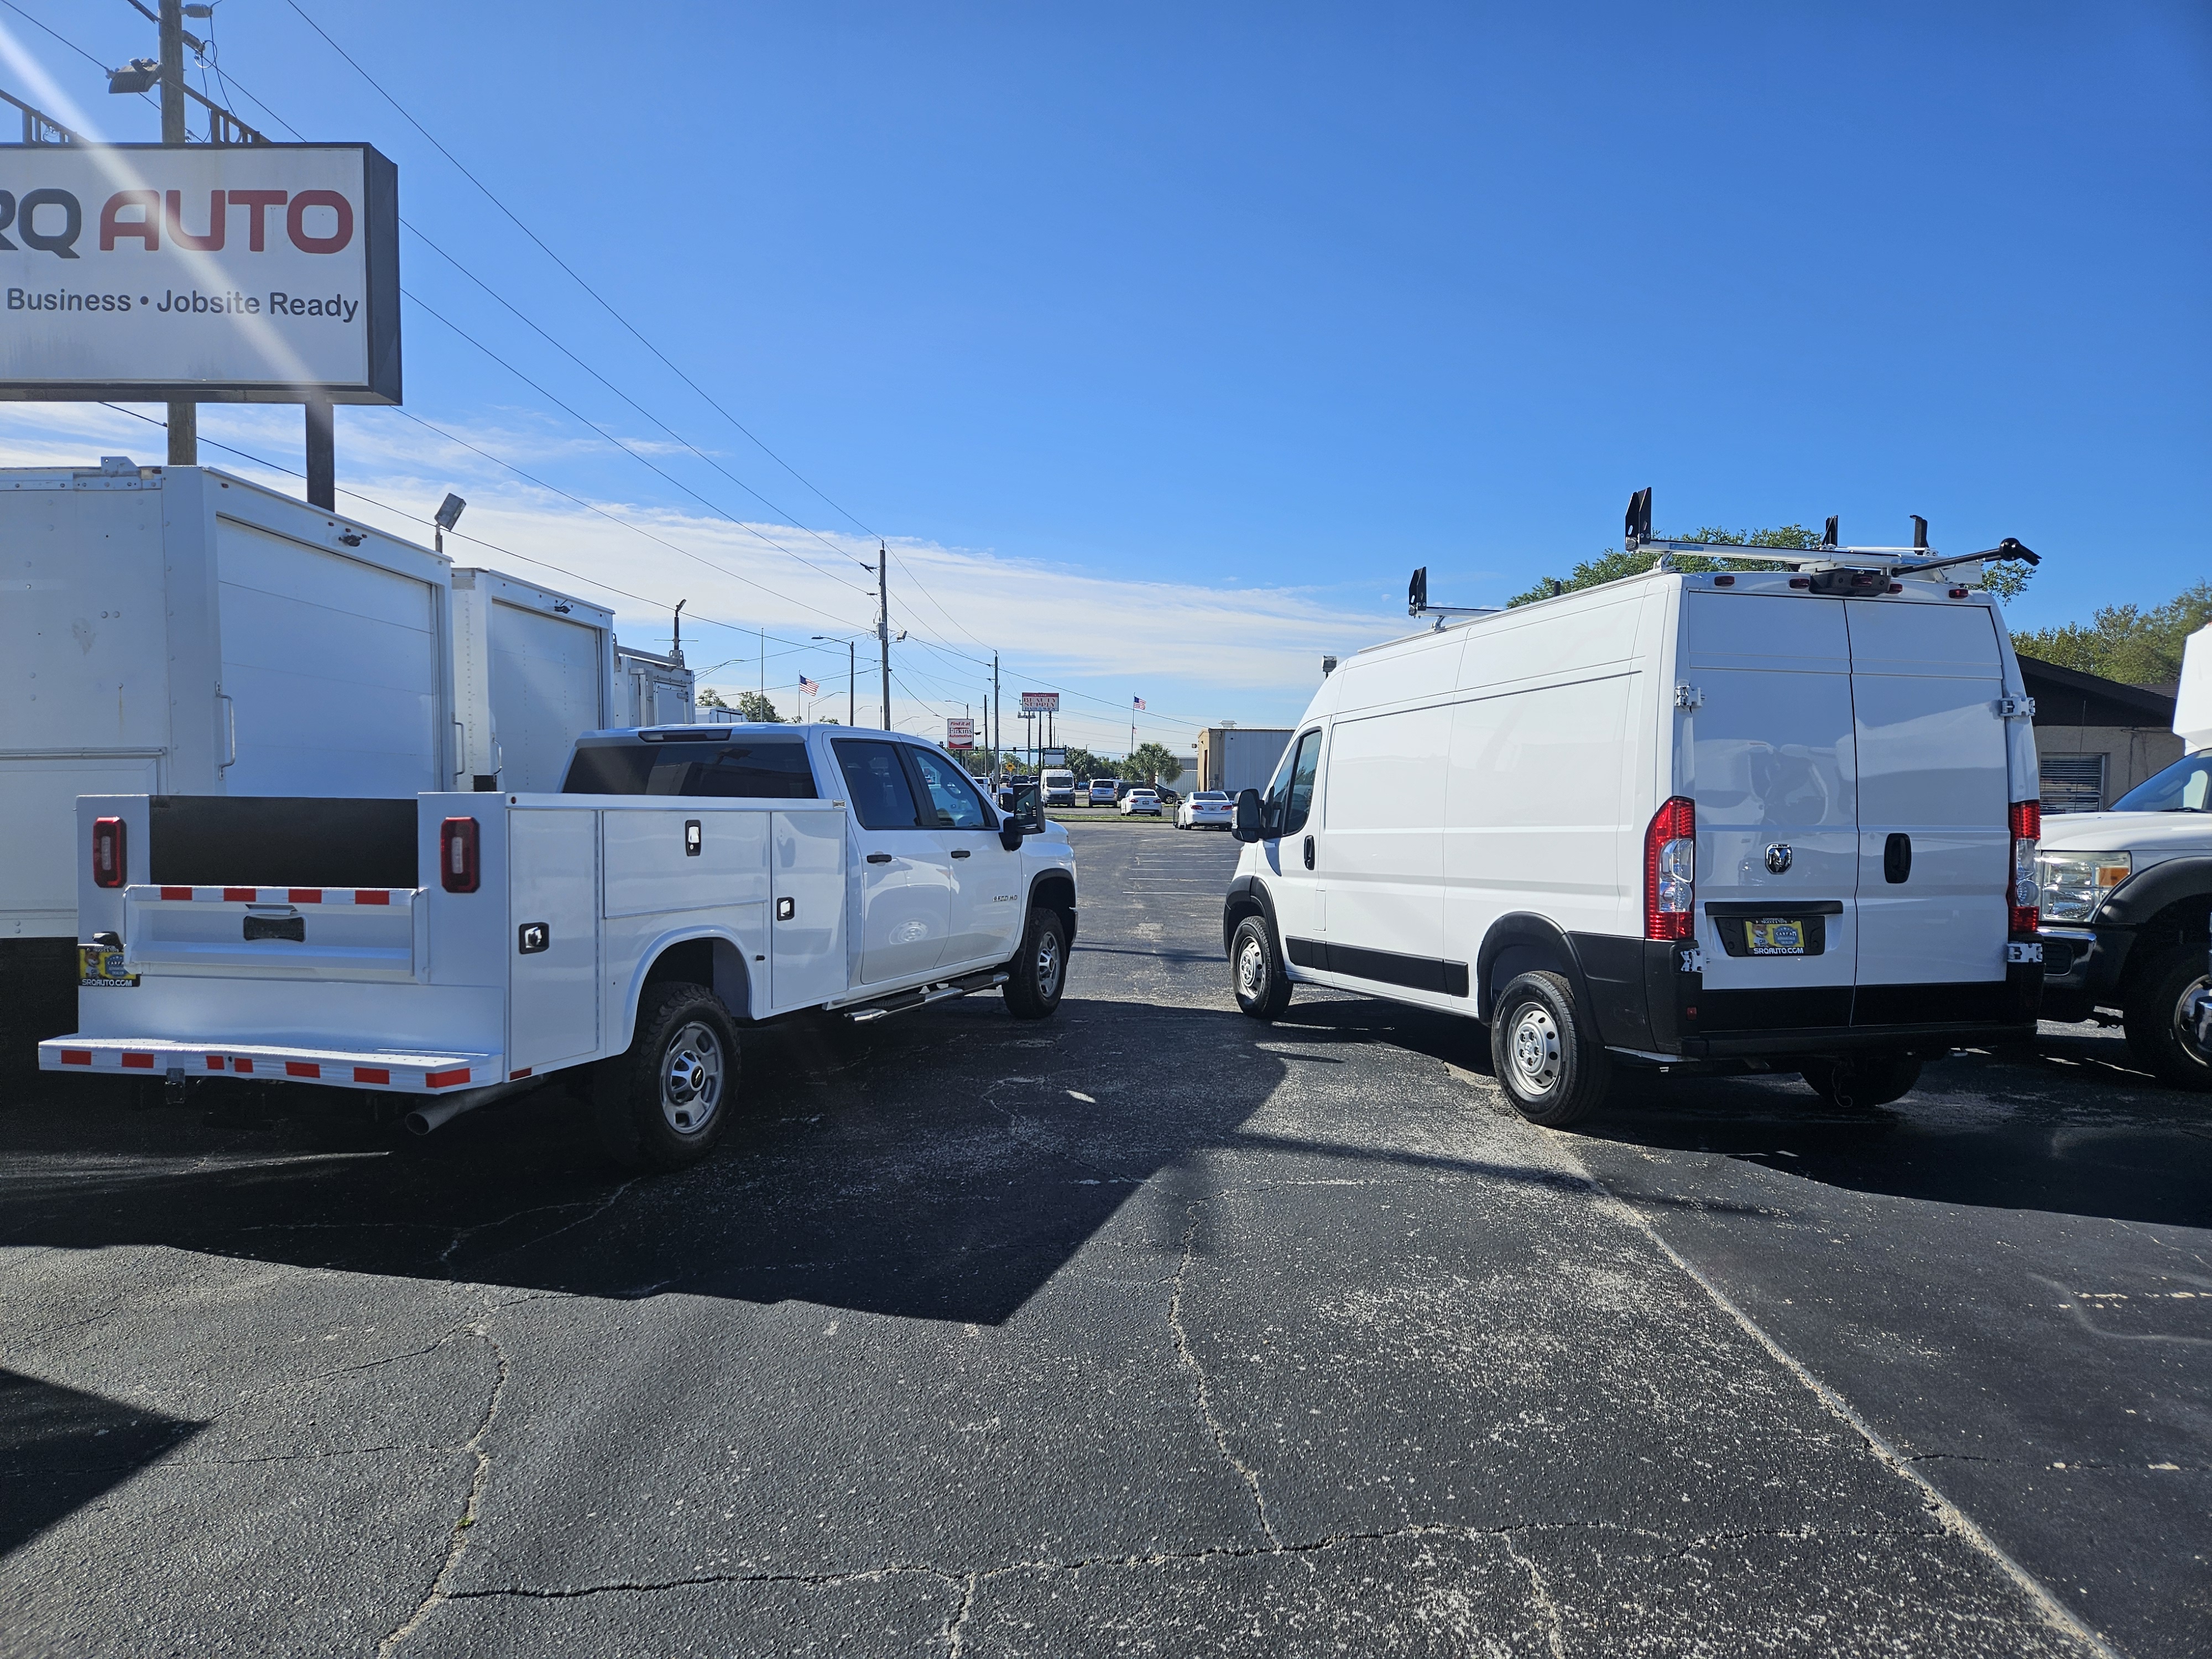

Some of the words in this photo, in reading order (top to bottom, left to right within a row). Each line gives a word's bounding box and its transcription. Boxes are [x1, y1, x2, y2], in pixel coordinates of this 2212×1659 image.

[0, 189, 82, 258] Q
[100, 189, 353, 254] AUTO
[7, 288, 131, 311] Business
[157, 289, 260, 314] Jobsite
[270, 292, 359, 323] Ready
